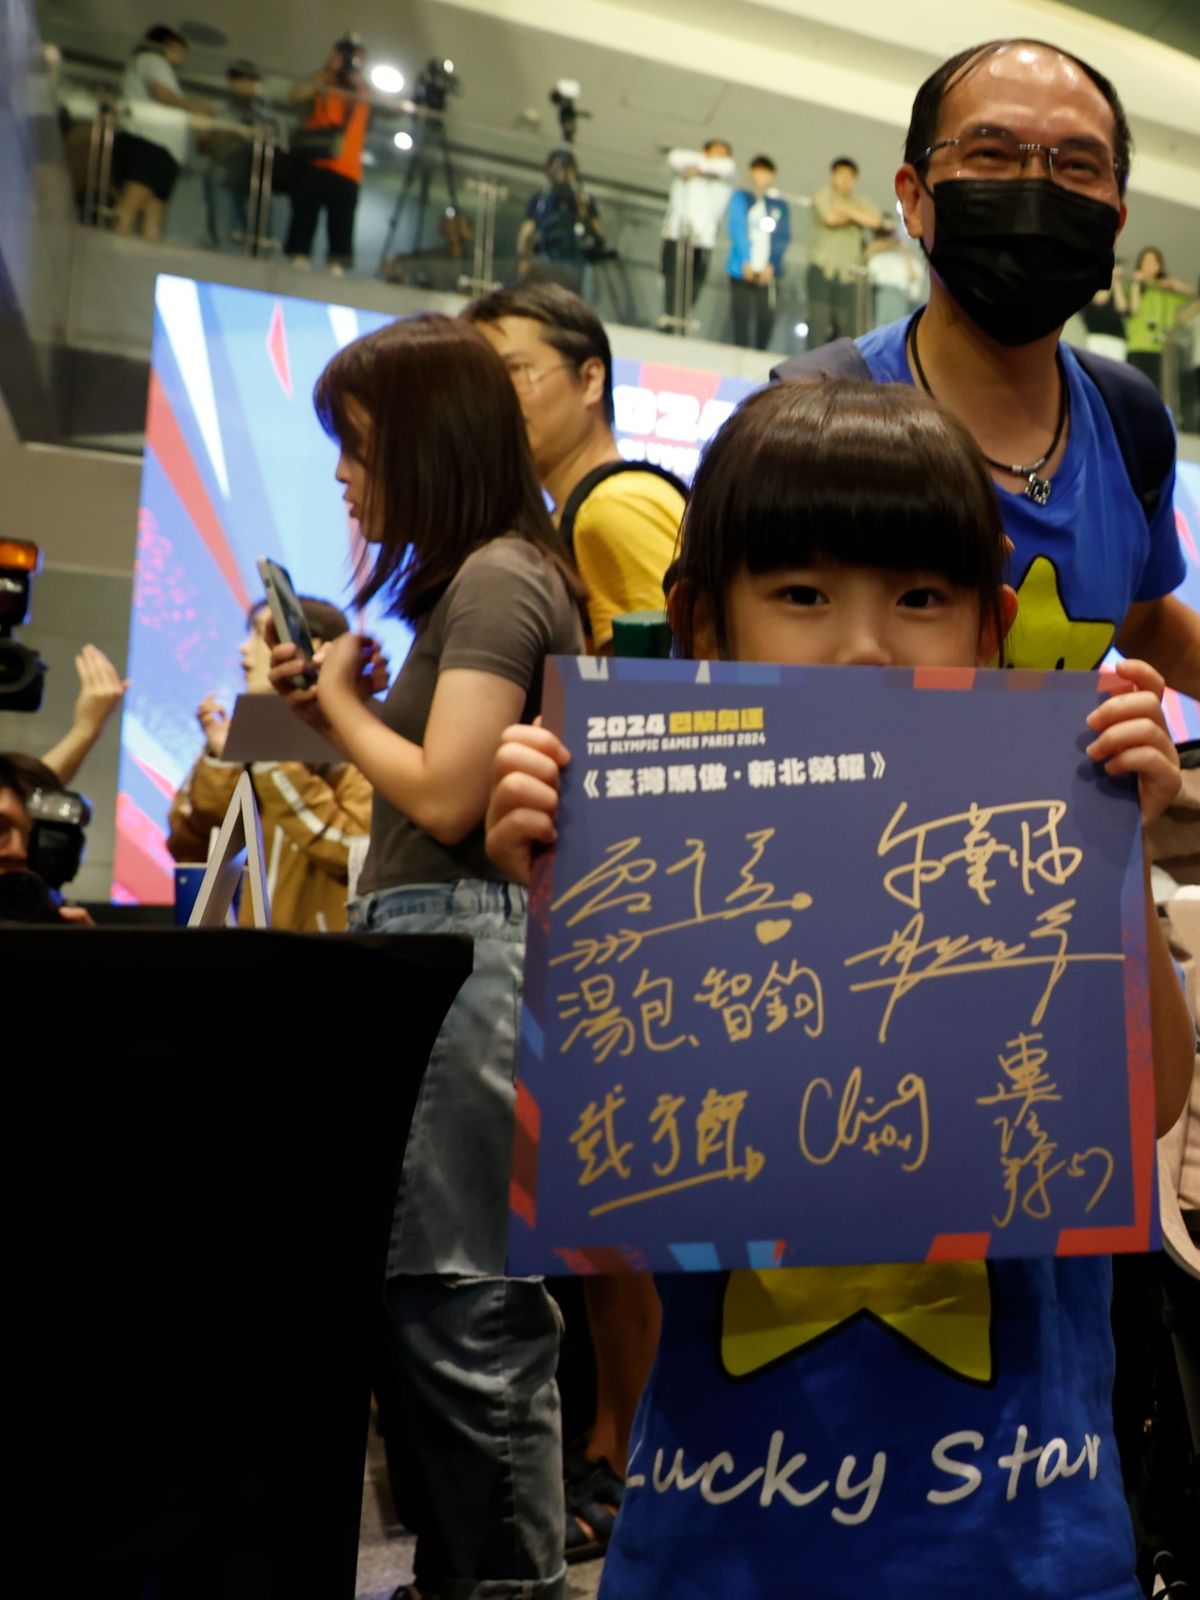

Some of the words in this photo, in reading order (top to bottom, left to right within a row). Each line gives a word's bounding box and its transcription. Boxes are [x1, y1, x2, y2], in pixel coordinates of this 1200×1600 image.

[586, 714, 666, 739] 2024
[586, 741, 608, 756] THE
[610, 738, 659, 754] OLYMPIC
[661, 735, 699, 751] GAMES
[701, 733, 735, 748] PARIS
[736, 731, 767, 747] 2024
[926, 1424, 1101, 1505] Star
